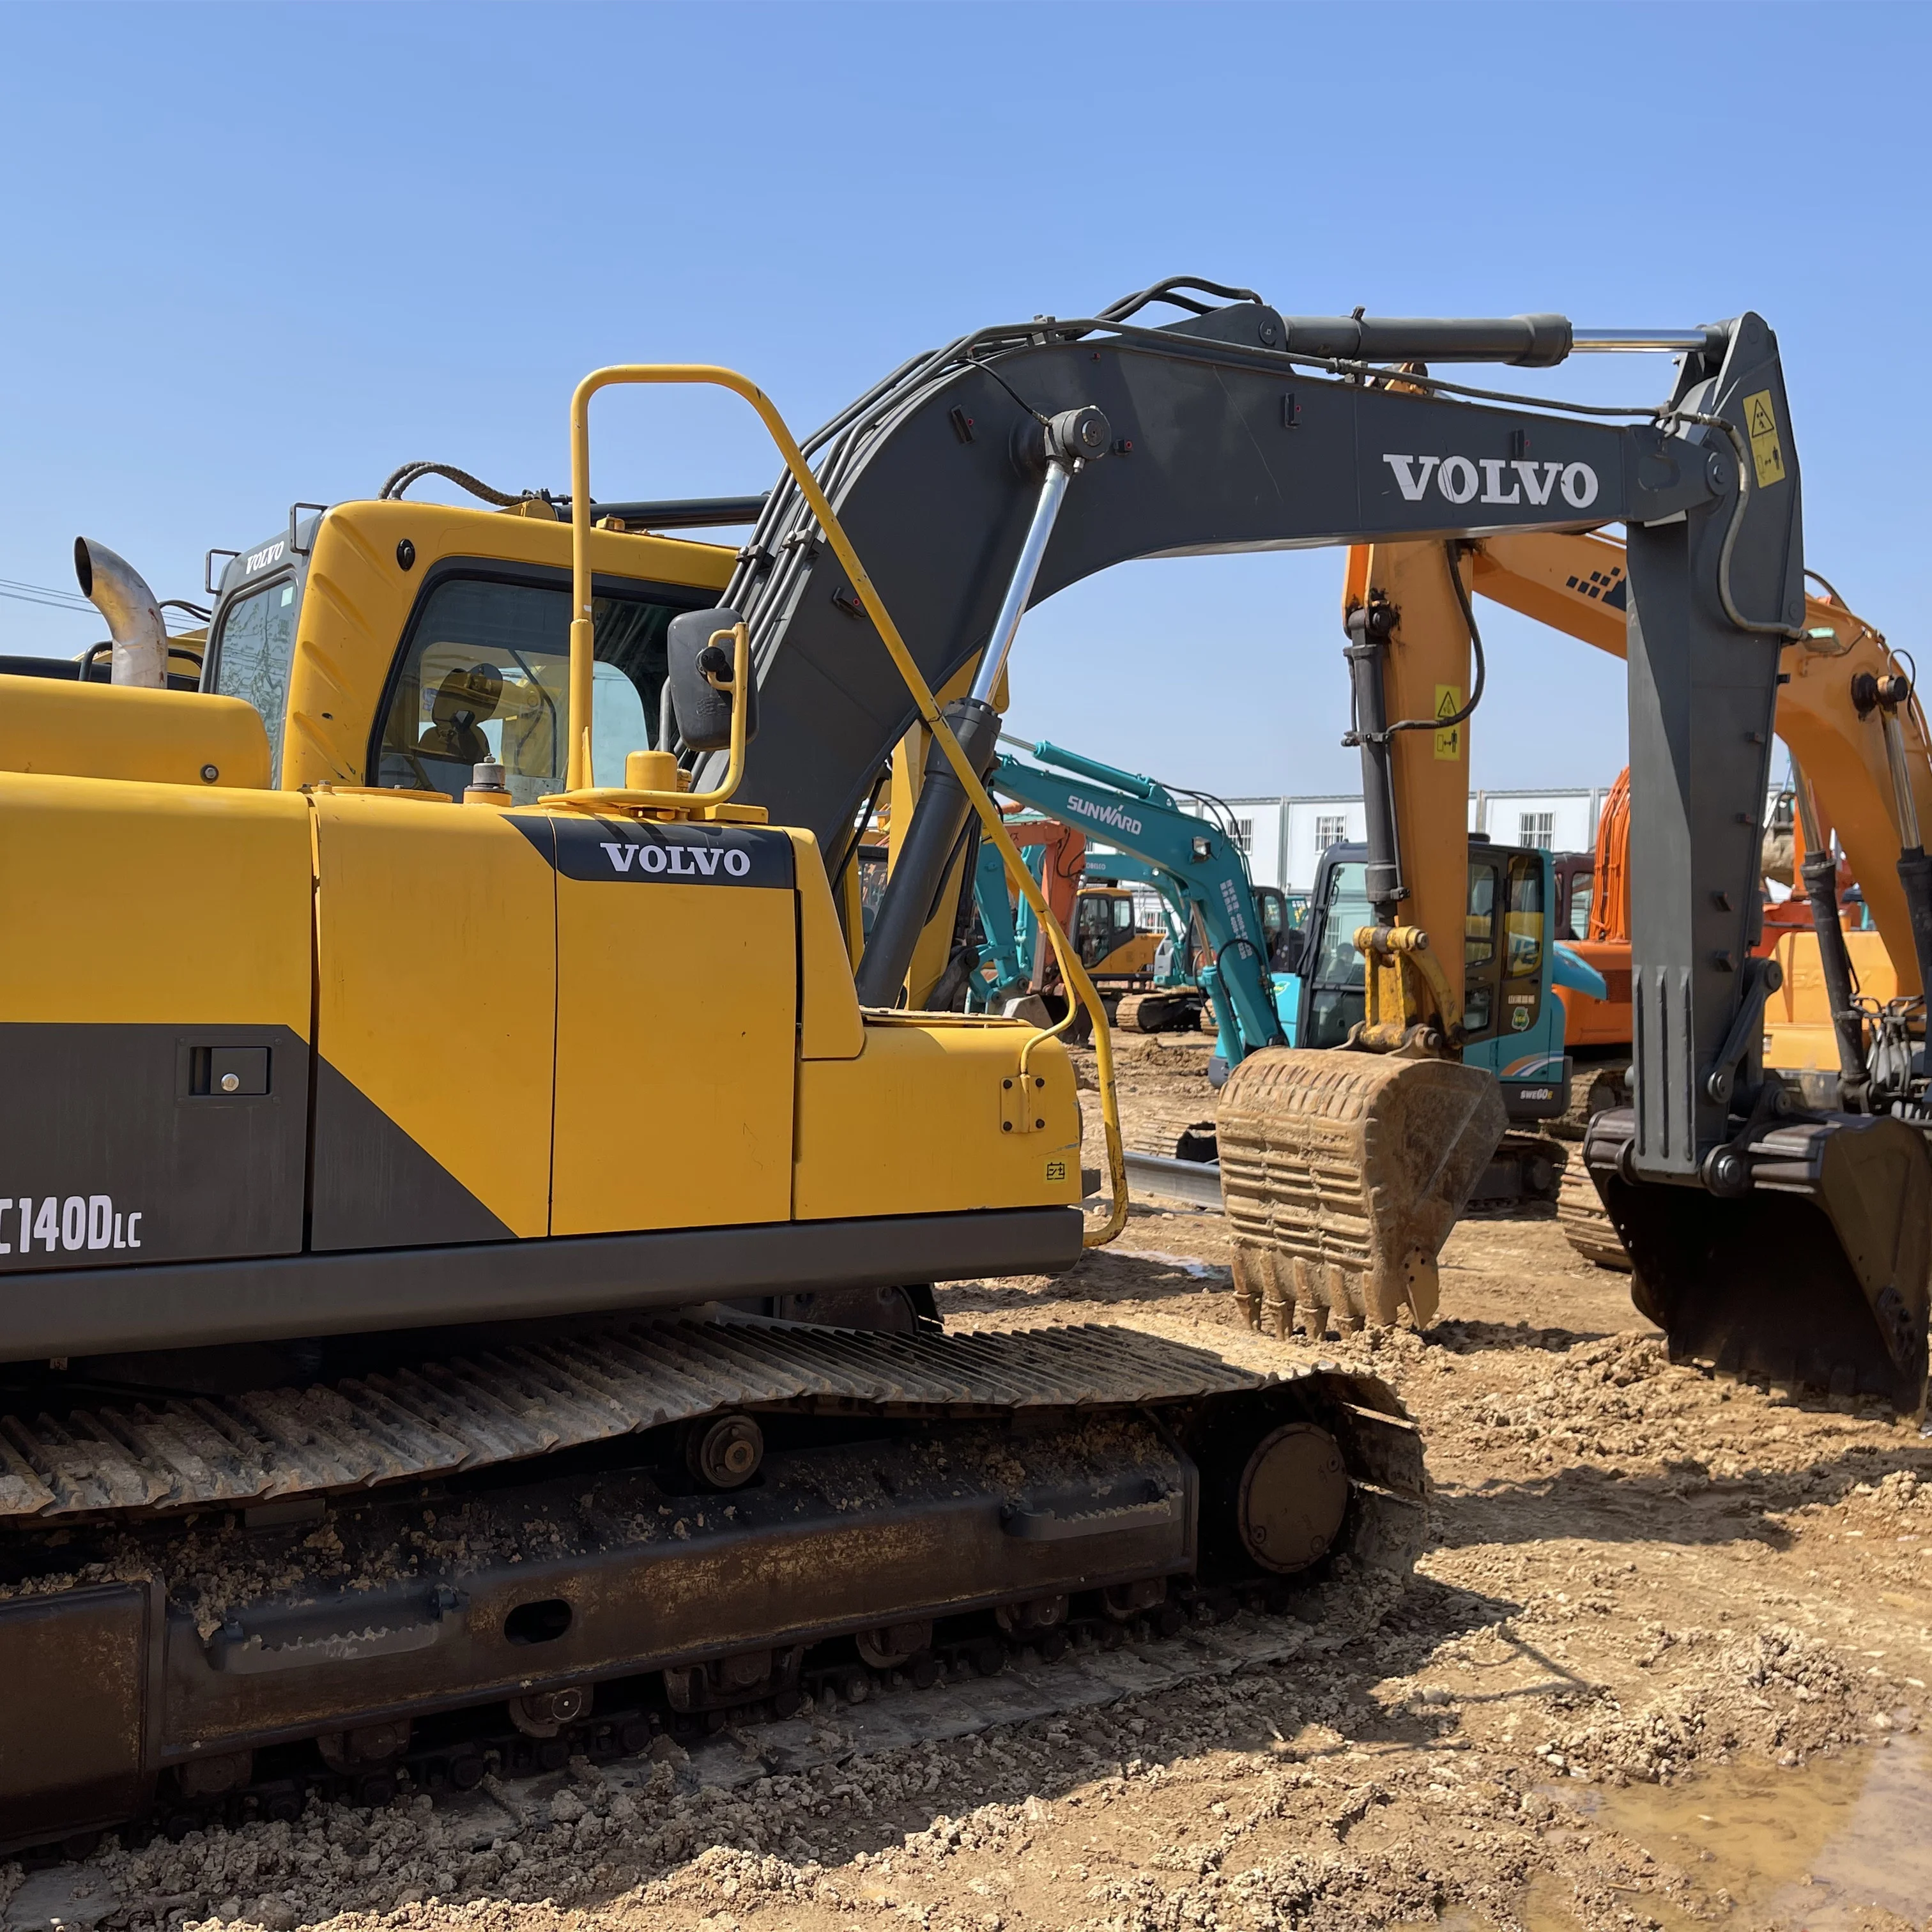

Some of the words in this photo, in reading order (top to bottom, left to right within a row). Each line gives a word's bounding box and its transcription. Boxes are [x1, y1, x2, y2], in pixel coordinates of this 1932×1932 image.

[1383, 454, 1598, 509] VOLVO
[246, 540, 284, 575] VOLVO
[1067, 795, 1142, 835] SUNWARD
[600, 842, 751, 877] VOLVO
[1085, 862, 1106, 870] OBELCO
